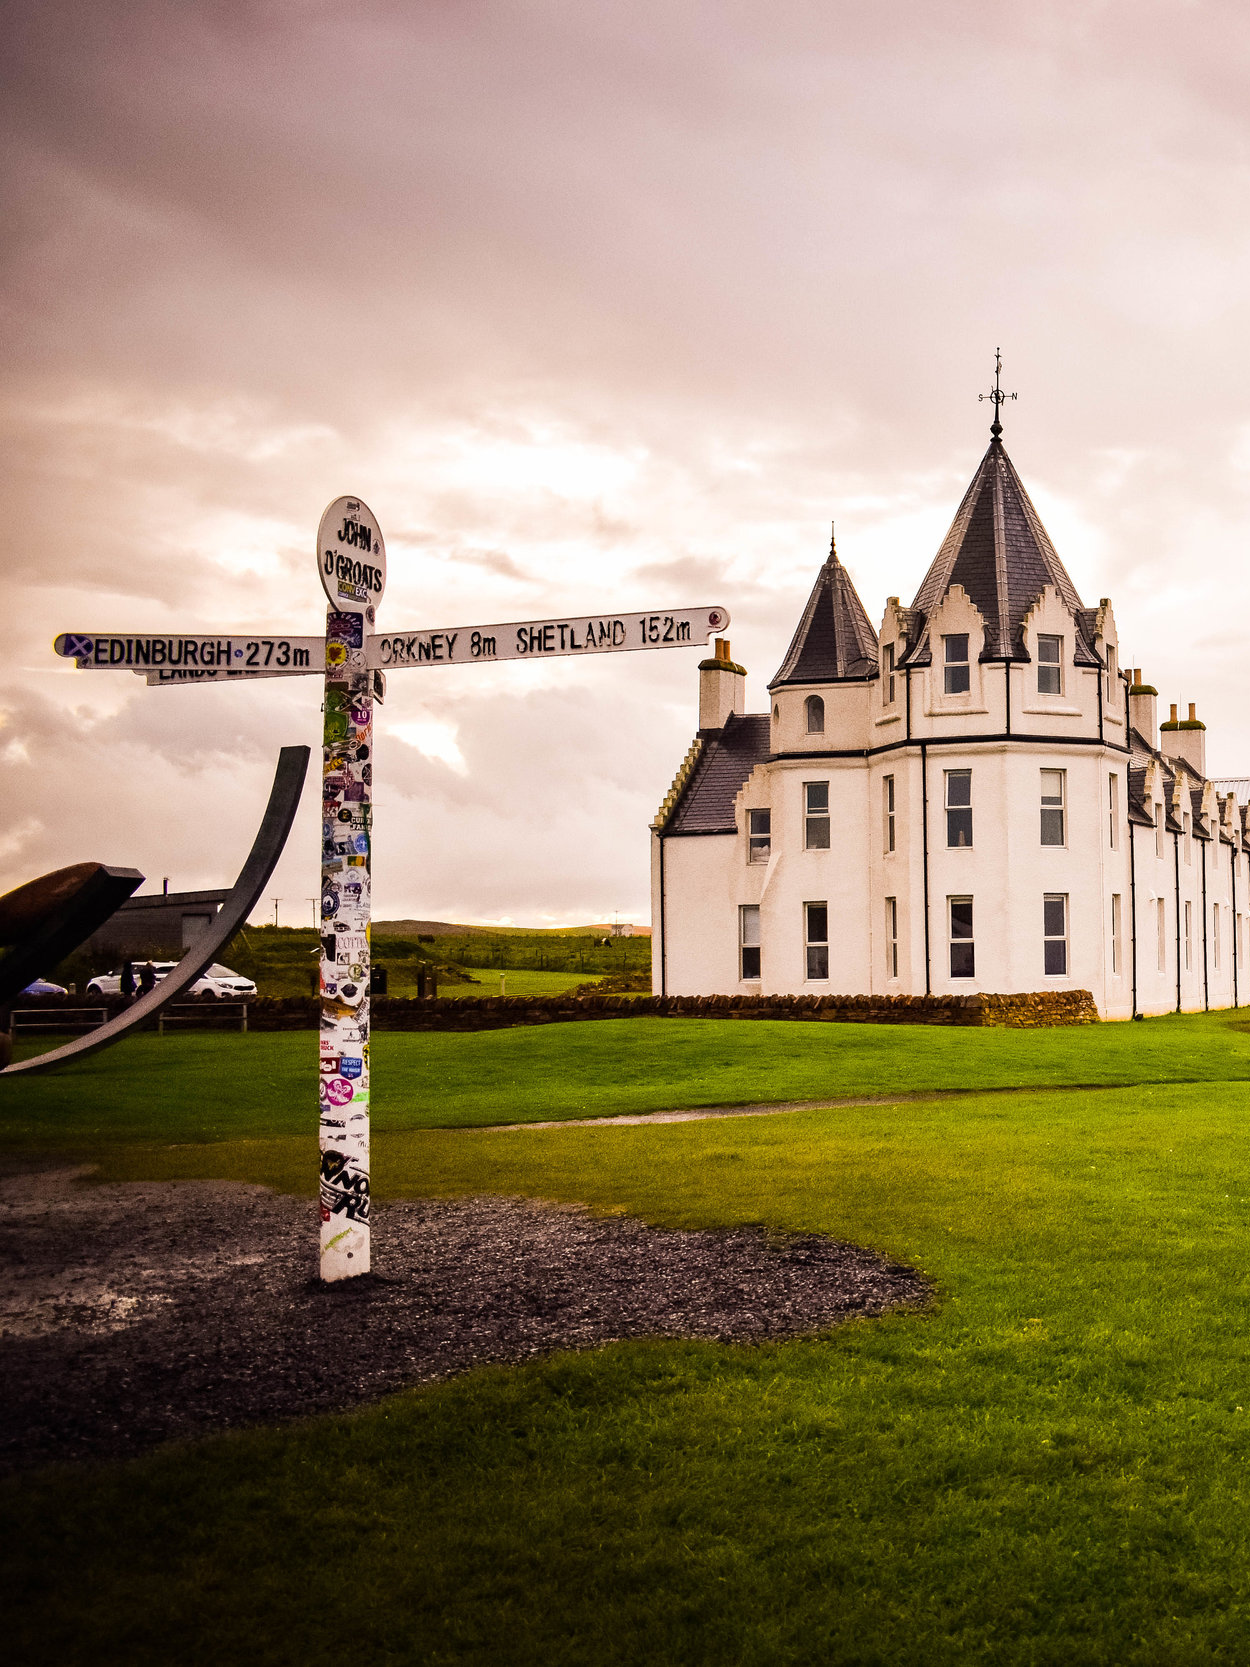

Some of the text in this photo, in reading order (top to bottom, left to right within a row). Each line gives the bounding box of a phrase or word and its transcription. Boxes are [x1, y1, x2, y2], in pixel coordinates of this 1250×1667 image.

[337, 517, 372, 553] JOHN
[324, 549, 383, 593] O'GROATS
[94, 638, 232, 666] EDINBURGH
[245, 640, 311, 667] 273m
[380, 632, 458, 664] ORKNEY
[470, 631, 497, 657] 8m
[516, 618, 627, 653] SHETLAND
[639, 616, 691, 645] 152m
